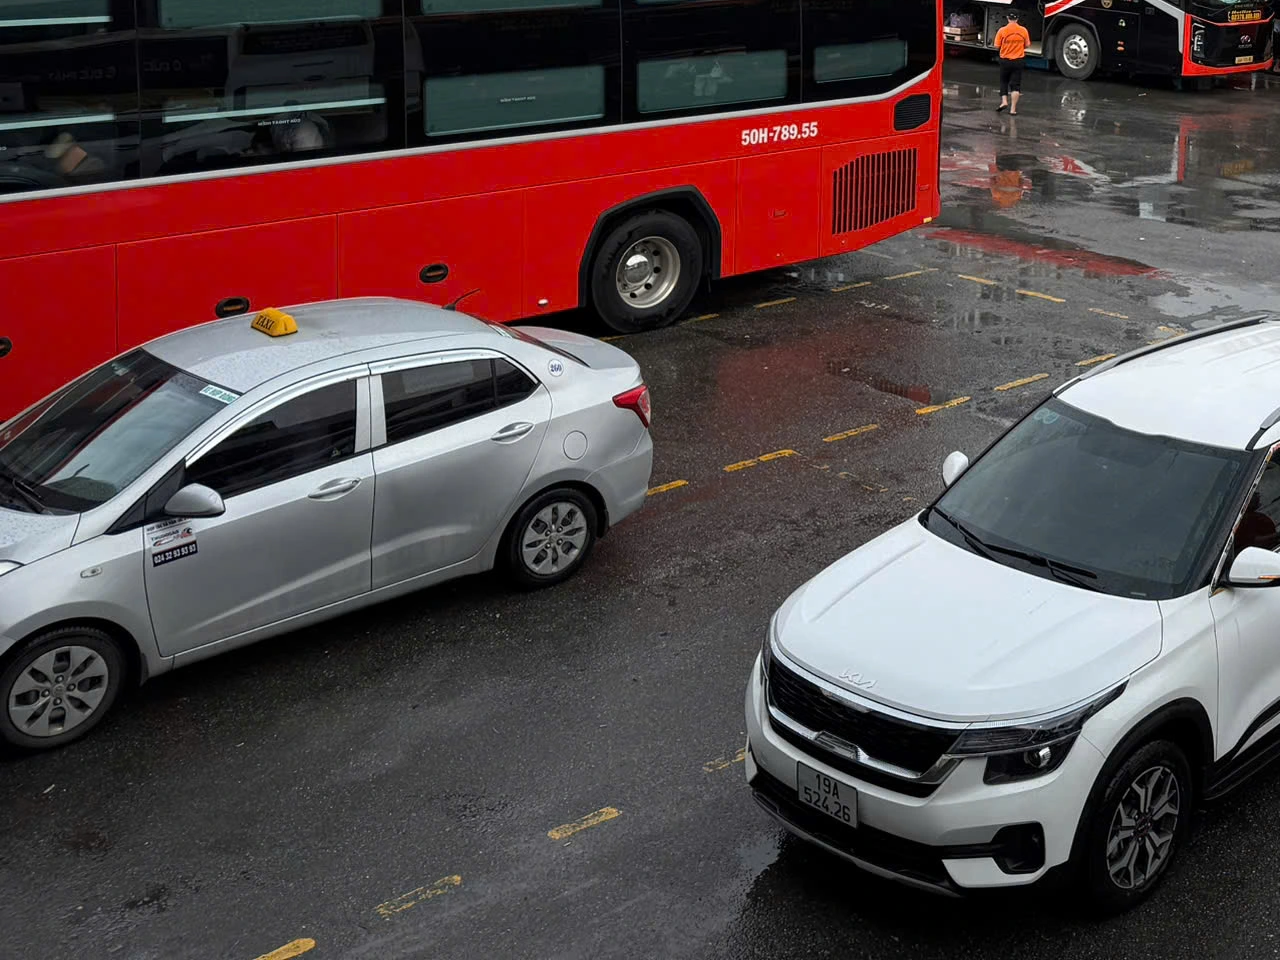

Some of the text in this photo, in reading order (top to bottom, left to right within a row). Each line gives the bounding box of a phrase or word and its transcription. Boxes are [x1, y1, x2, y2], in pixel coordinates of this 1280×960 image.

[741, 122, 818, 145] 50H-789.55
[256, 316, 274, 330] TAXI
[816, 774, 840, 799] 19A
[804, 786, 850, 823] 524.26
